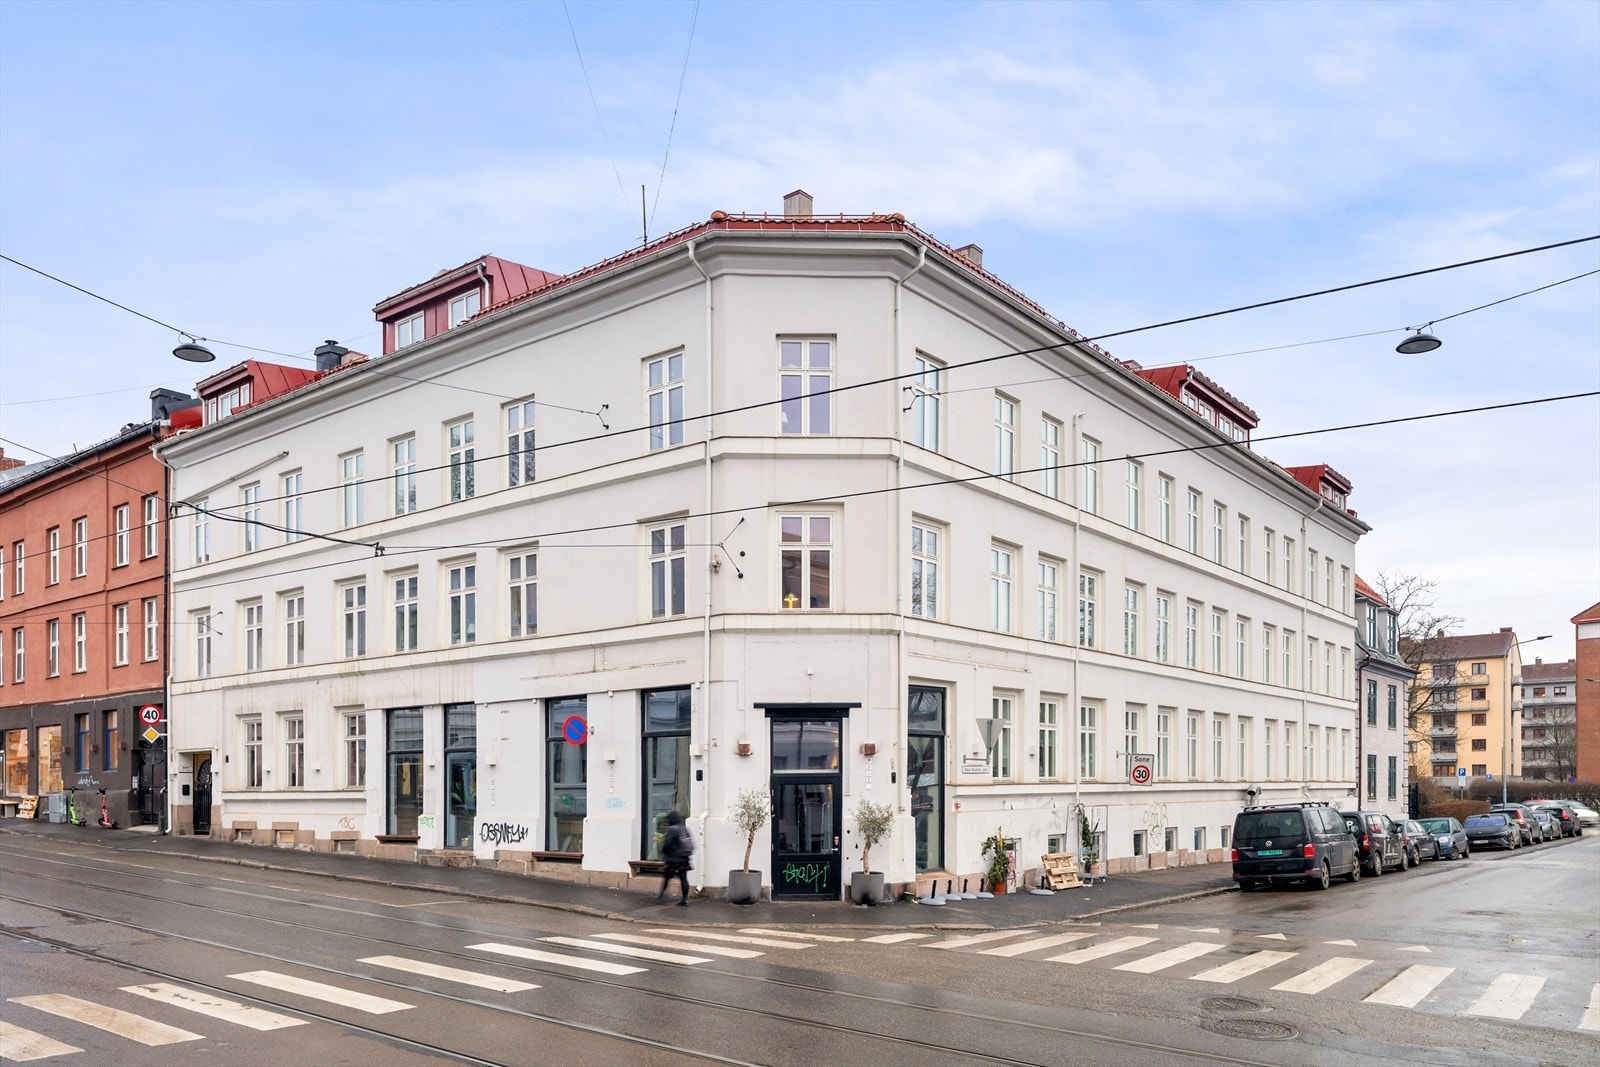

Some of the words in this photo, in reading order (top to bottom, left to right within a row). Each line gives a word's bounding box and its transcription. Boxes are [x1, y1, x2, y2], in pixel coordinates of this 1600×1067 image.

[144, 710, 158, 720] 40
[1134, 755, 1150, 763] Sone
[1135, 769, 1147, 779] 30
